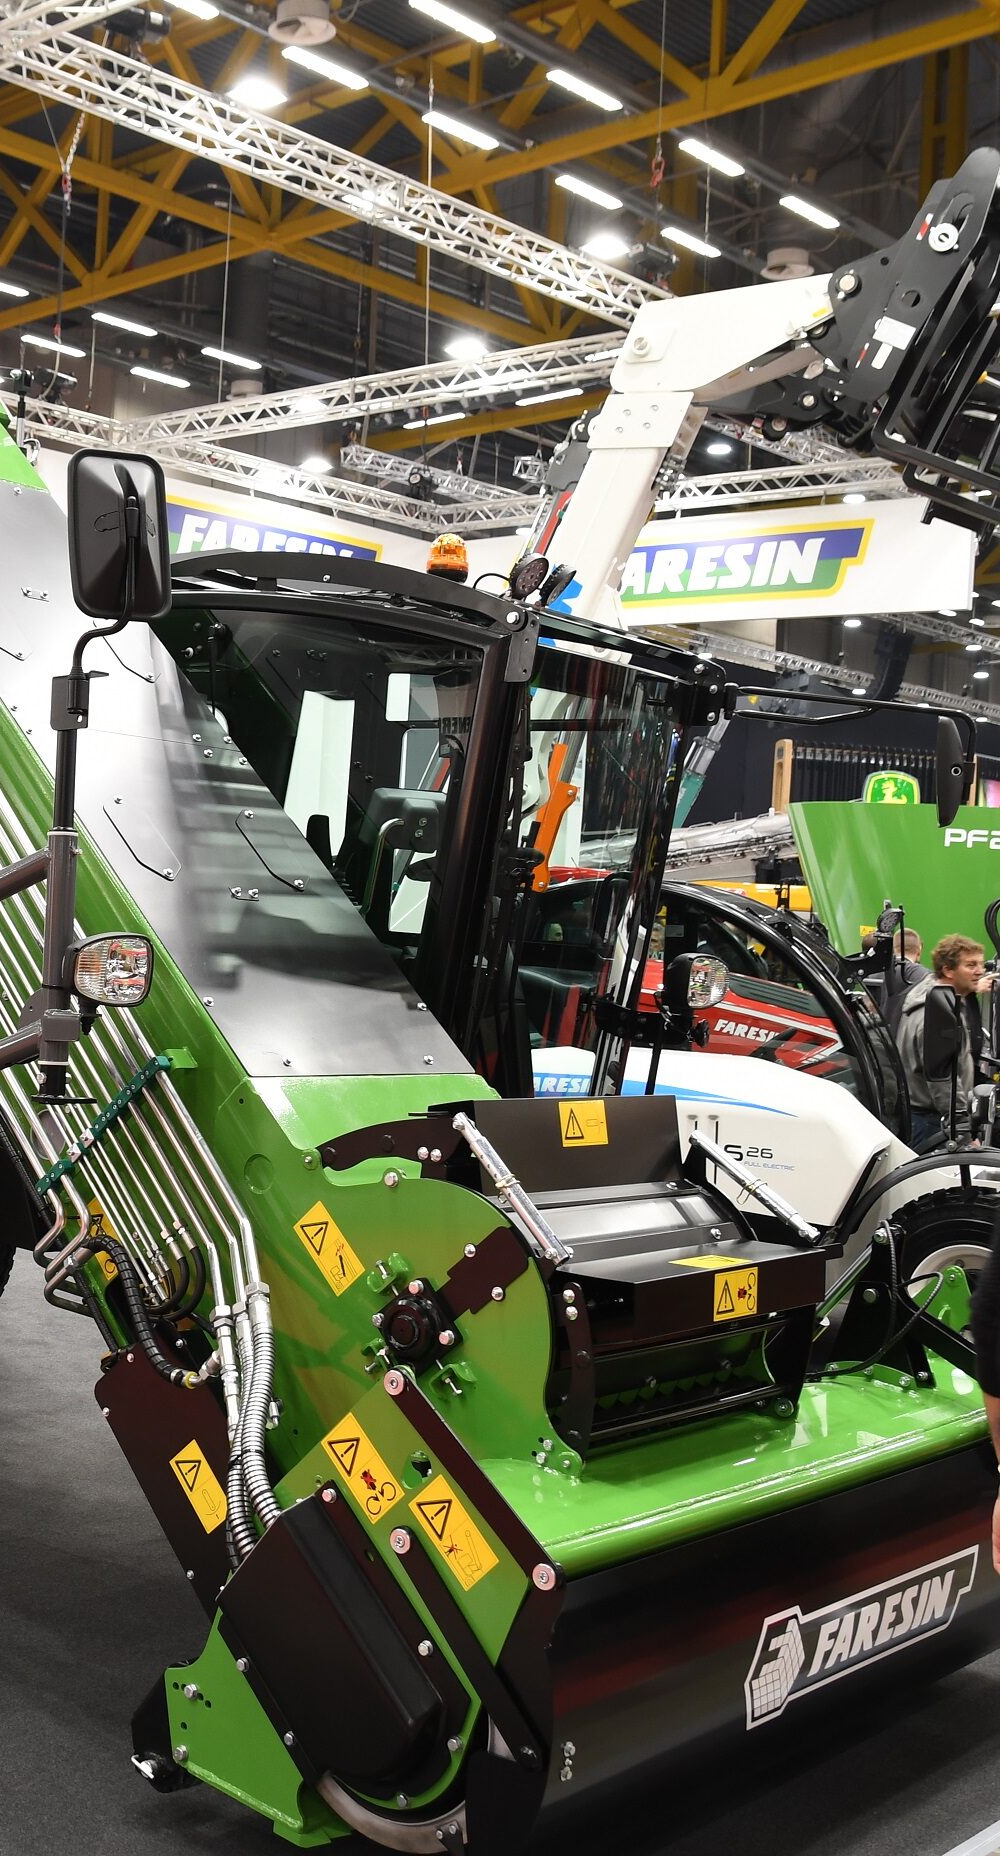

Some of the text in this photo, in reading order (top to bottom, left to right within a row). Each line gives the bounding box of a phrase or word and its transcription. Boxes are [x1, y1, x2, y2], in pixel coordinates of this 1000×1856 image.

[724, 1144, 773, 1161] S 26
[743, 1160, 795, 1171] FULL ELECTRIC
[807, 1569, 955, 1678] FARESIN
